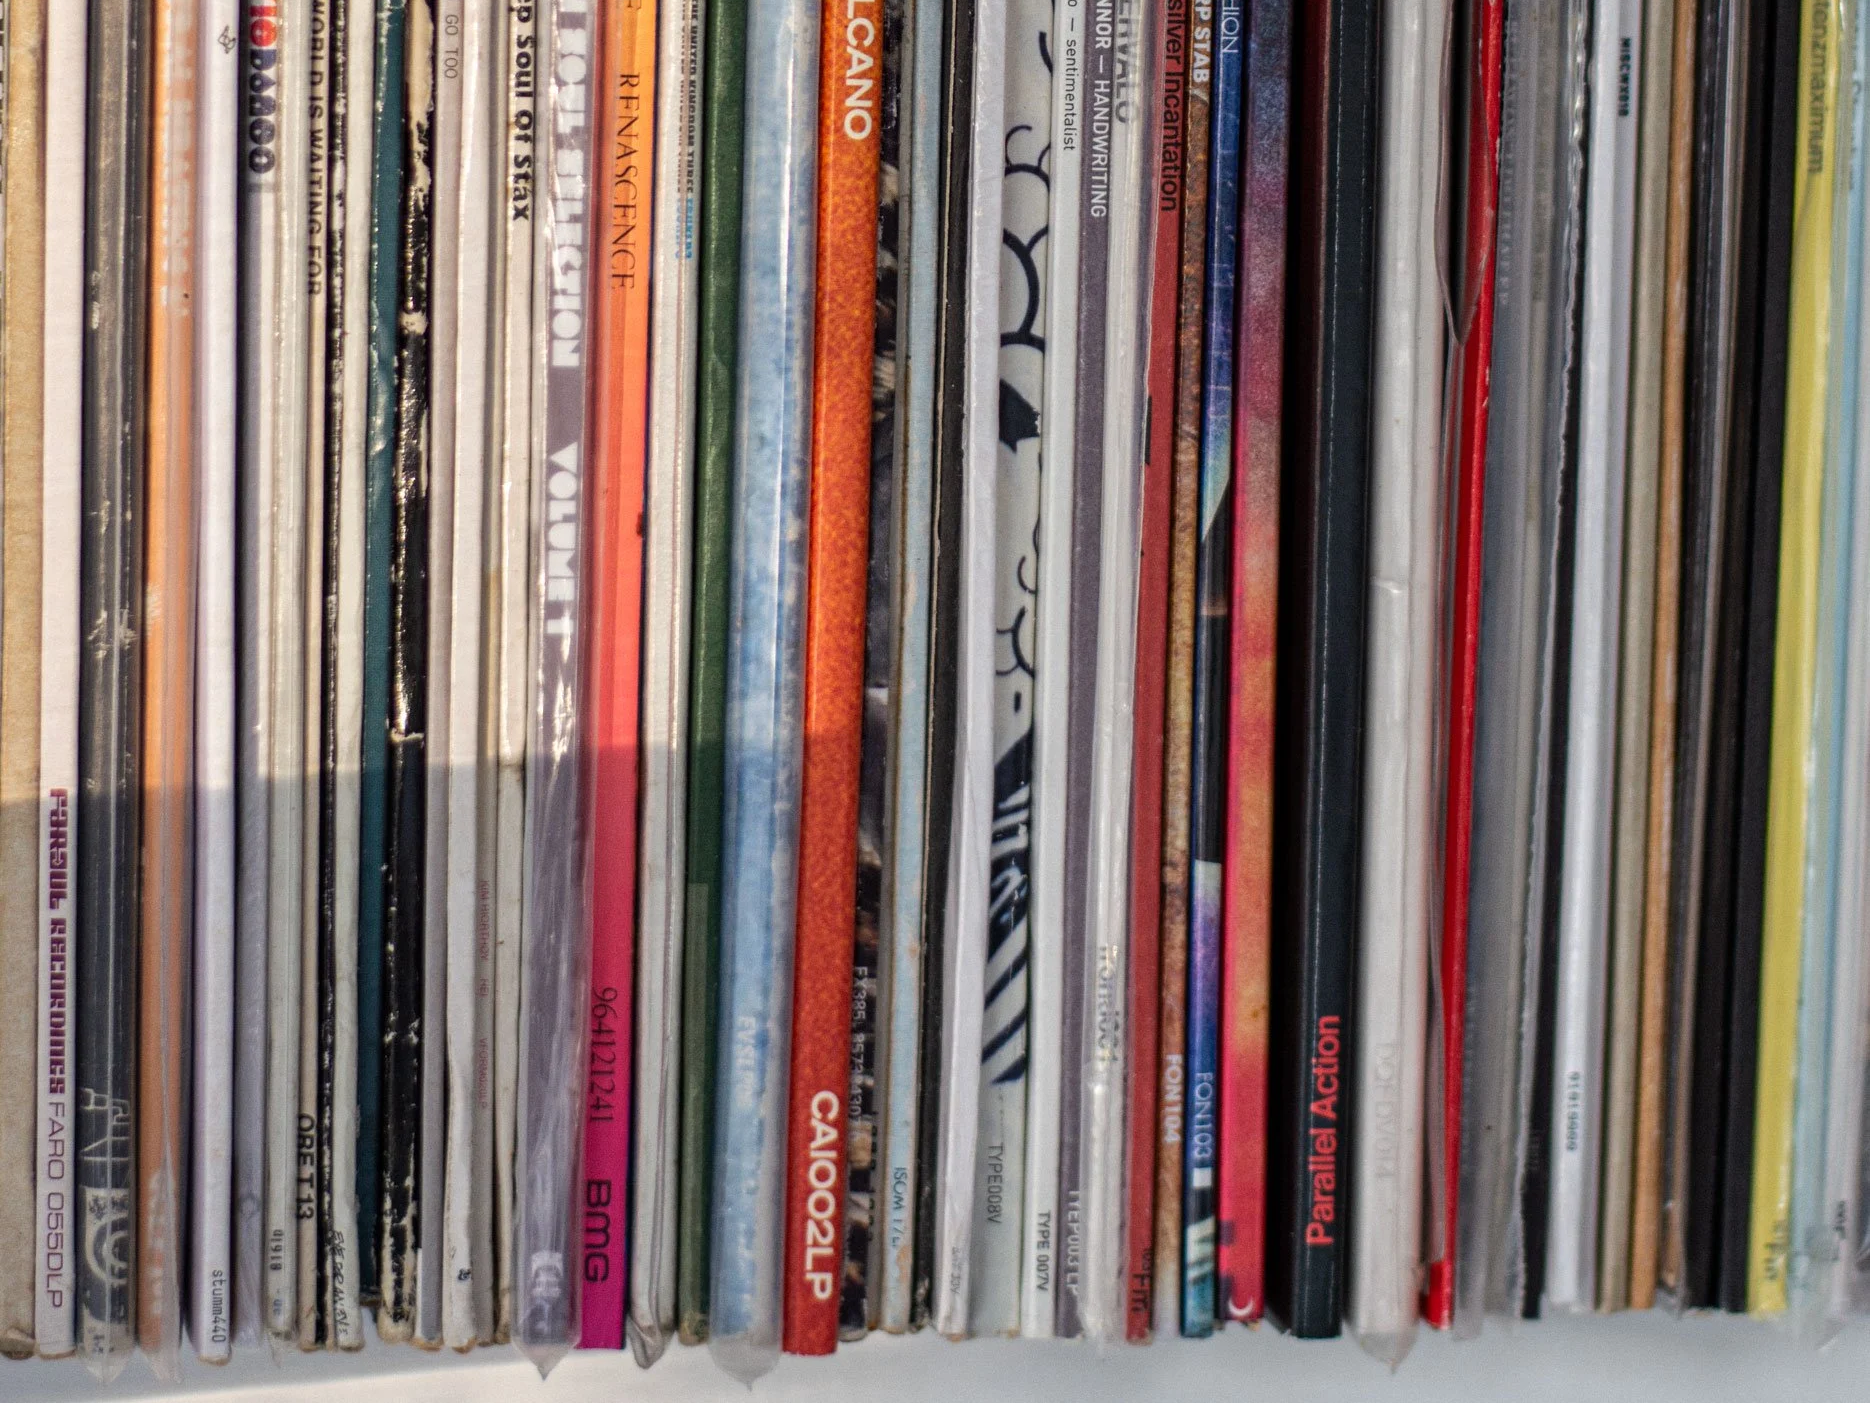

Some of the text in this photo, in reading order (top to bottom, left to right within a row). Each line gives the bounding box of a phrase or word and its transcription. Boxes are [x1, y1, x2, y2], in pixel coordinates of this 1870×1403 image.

[445, 15, 458, 36] GO
[445, 48, 458, 79] TOO
[516, 34, 534, 96] Soul
[1193, 26, 1210, 82] STAB
[310, 96, 324, 118] IS
[558, 28, 587, 135] SOUL
[1063, 39, 1079, 151] sentimentalist
[516, 109, 534, 143] Of
[1091, 79, 1110, 218] HANDWRITING
[1161, 71, 1182, 212] Incantation
[309, 129, 323, 234] WAITING
[513, 154, 532, 222] Stax
[610, 72, 640, 290] RENASCENCE
[308, 245, 322, 296] FOR
[552, 148, 584, 367] SELECTION
[547, 441, 578, 602] VOLUME
[46, 918, 66, 1308] RECORDINGS FARO 055DLP
[585, 987, 618, 1283] 964121241 BMG
[1163, 1053, 1182, 1143] FON104
[1195, 1072, 1212, 1157] FON103
[1305, 1015, 1340, 1245] Parallel Action
[296, 1195, 313, 1221] 13
[892, 1167, 907, 1210] ISOM
[987, 1142, 1003, 1224] TYPE008V
[1035, 1211, 1051, 1291] TYPE 007V
[211, 1269, 226, 1342] stumm440
